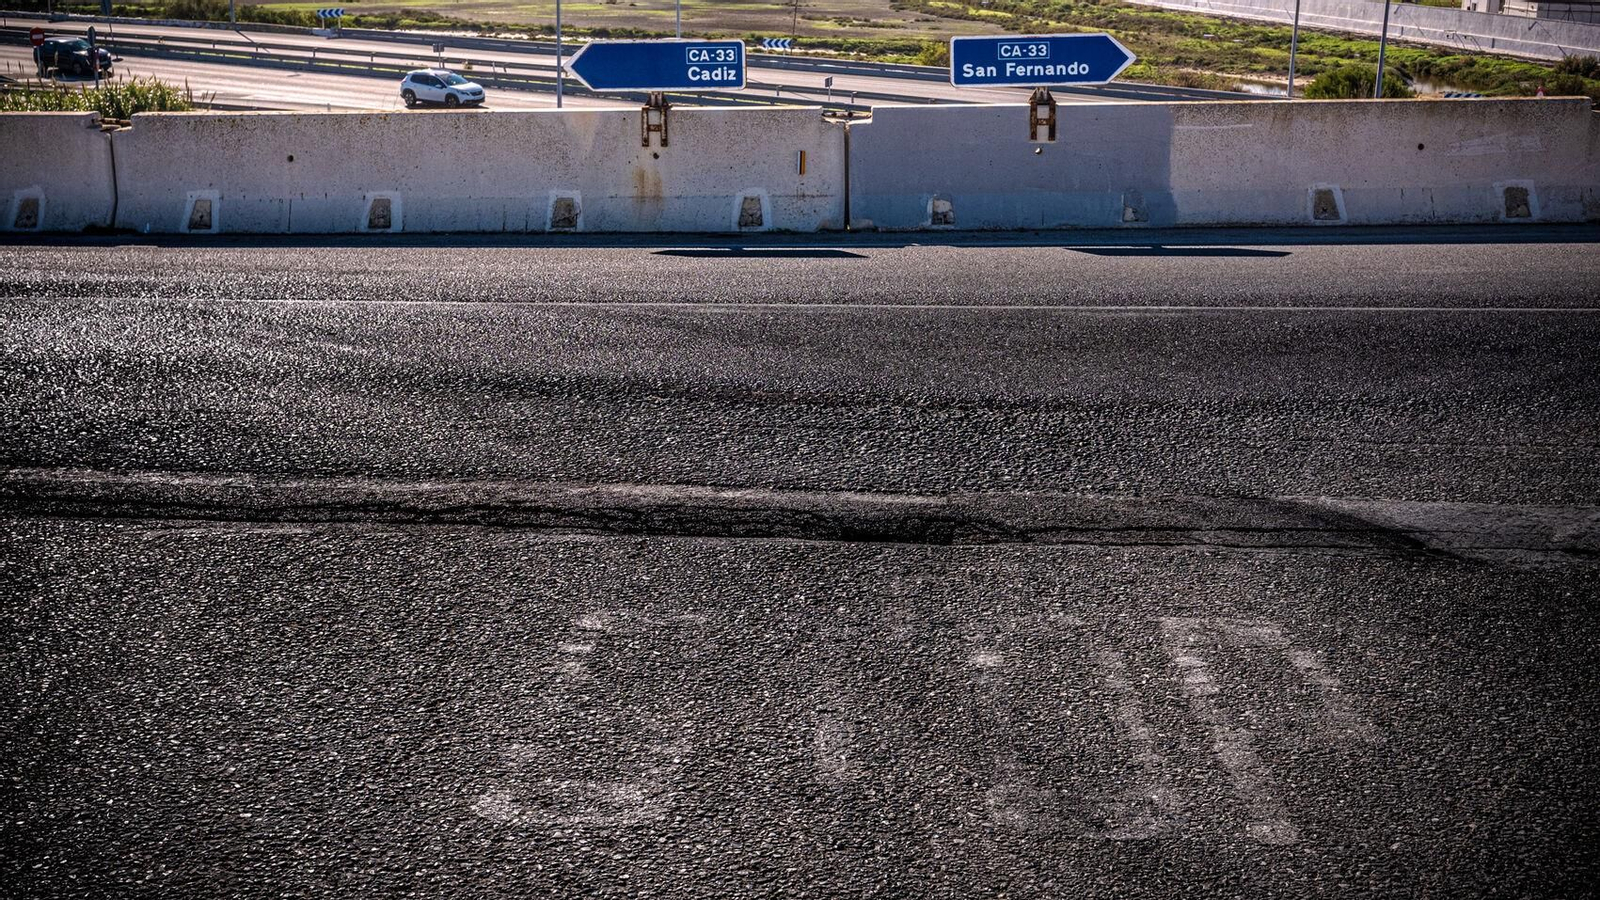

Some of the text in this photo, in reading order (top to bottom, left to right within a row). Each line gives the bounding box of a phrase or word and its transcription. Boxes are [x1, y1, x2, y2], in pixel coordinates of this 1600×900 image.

[689, 49, 735, 62] CA-33
[1001, 44, 1047, 57] CA-33
[688, 66, 737, 81] Cadiz
[963, 61, 1089, 78] San Fernando
